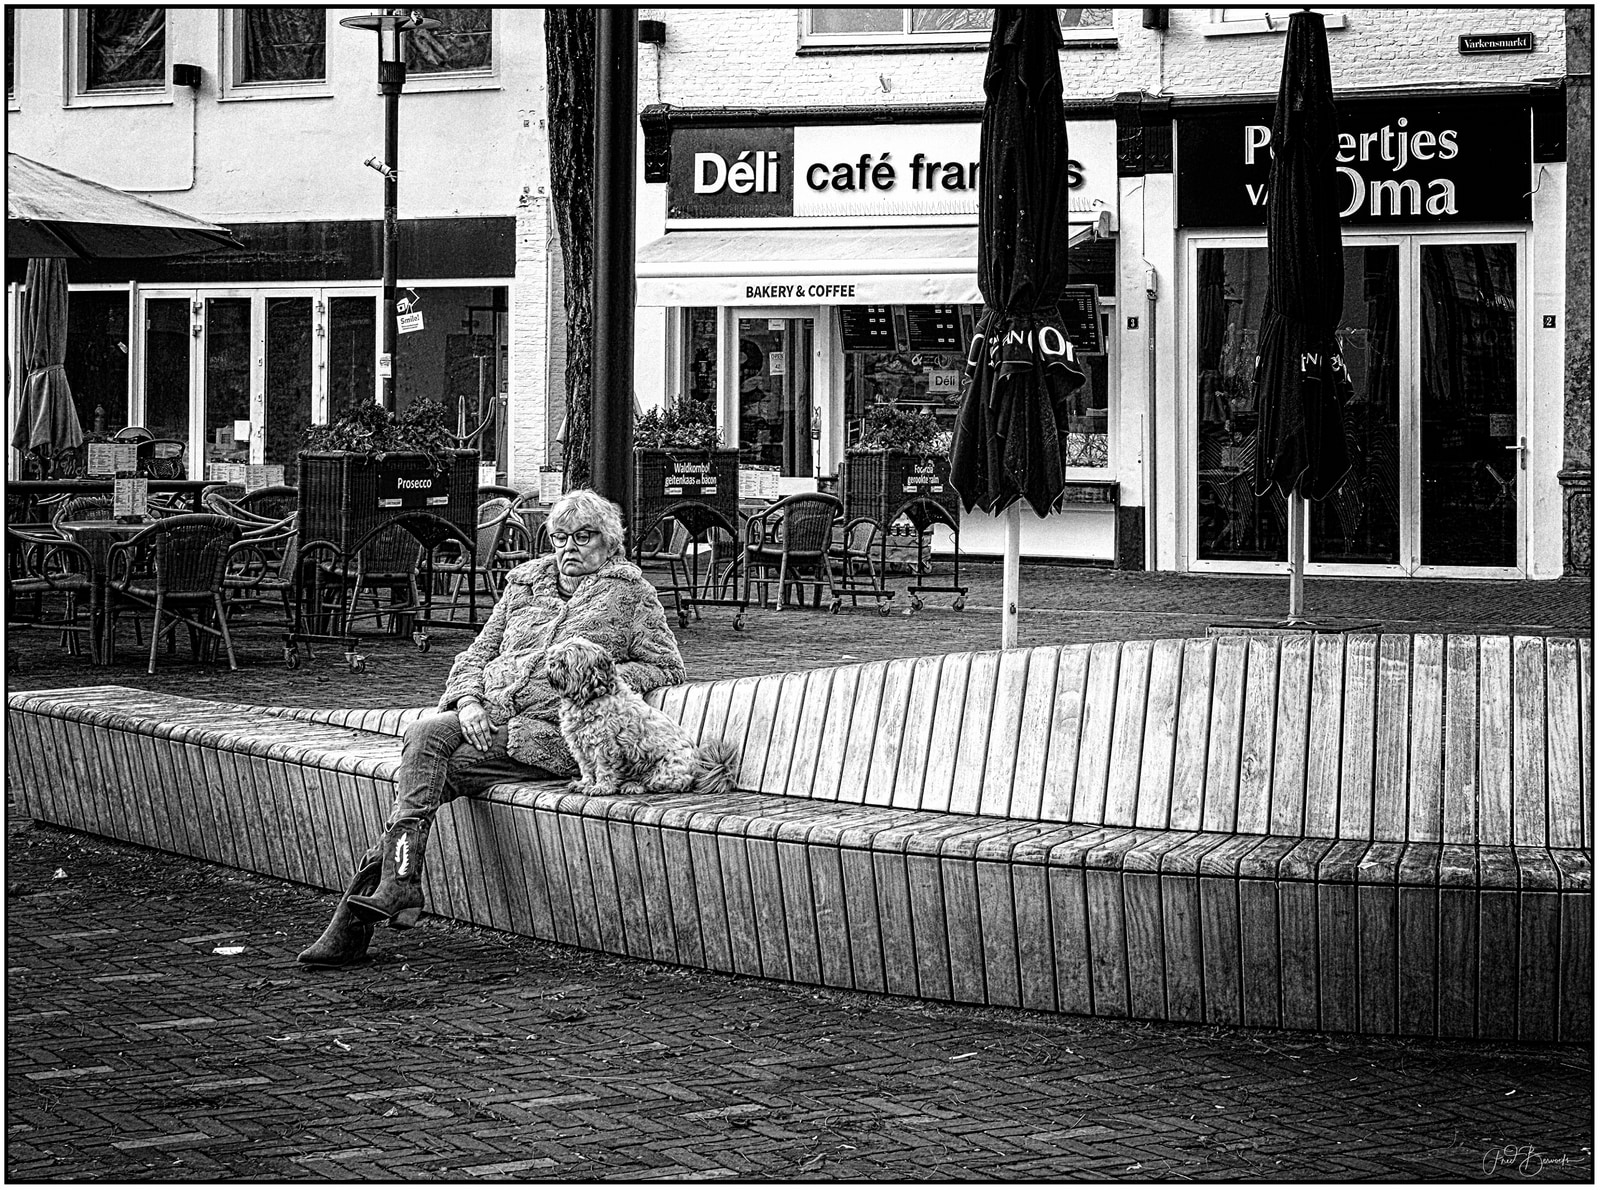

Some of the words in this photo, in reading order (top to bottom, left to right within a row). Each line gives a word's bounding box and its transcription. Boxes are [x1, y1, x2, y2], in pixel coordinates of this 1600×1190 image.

[1464, 37, 1527, 49] Varkensmarkt
[1245, 117, 1459, 172] Pertjes
[694, 150, 778, 193] Déli
[806, 152, 896, 191] café
[909, 153, 1084, 191] frans
[746, 285, 794, 298] BAKERY
[796, 285, 806, 297] &
[808, 284, 856, 297] COFFEE
[401, 314, 420, 324] Smile!
[1130, 318, 1136, 328] 3
[1546, 317, 1553, 326] 2
[935, 375, 956, 386] Déli
[397, 477, 432, 489] Prosecco
[701, 472, 717, 485] bacon
